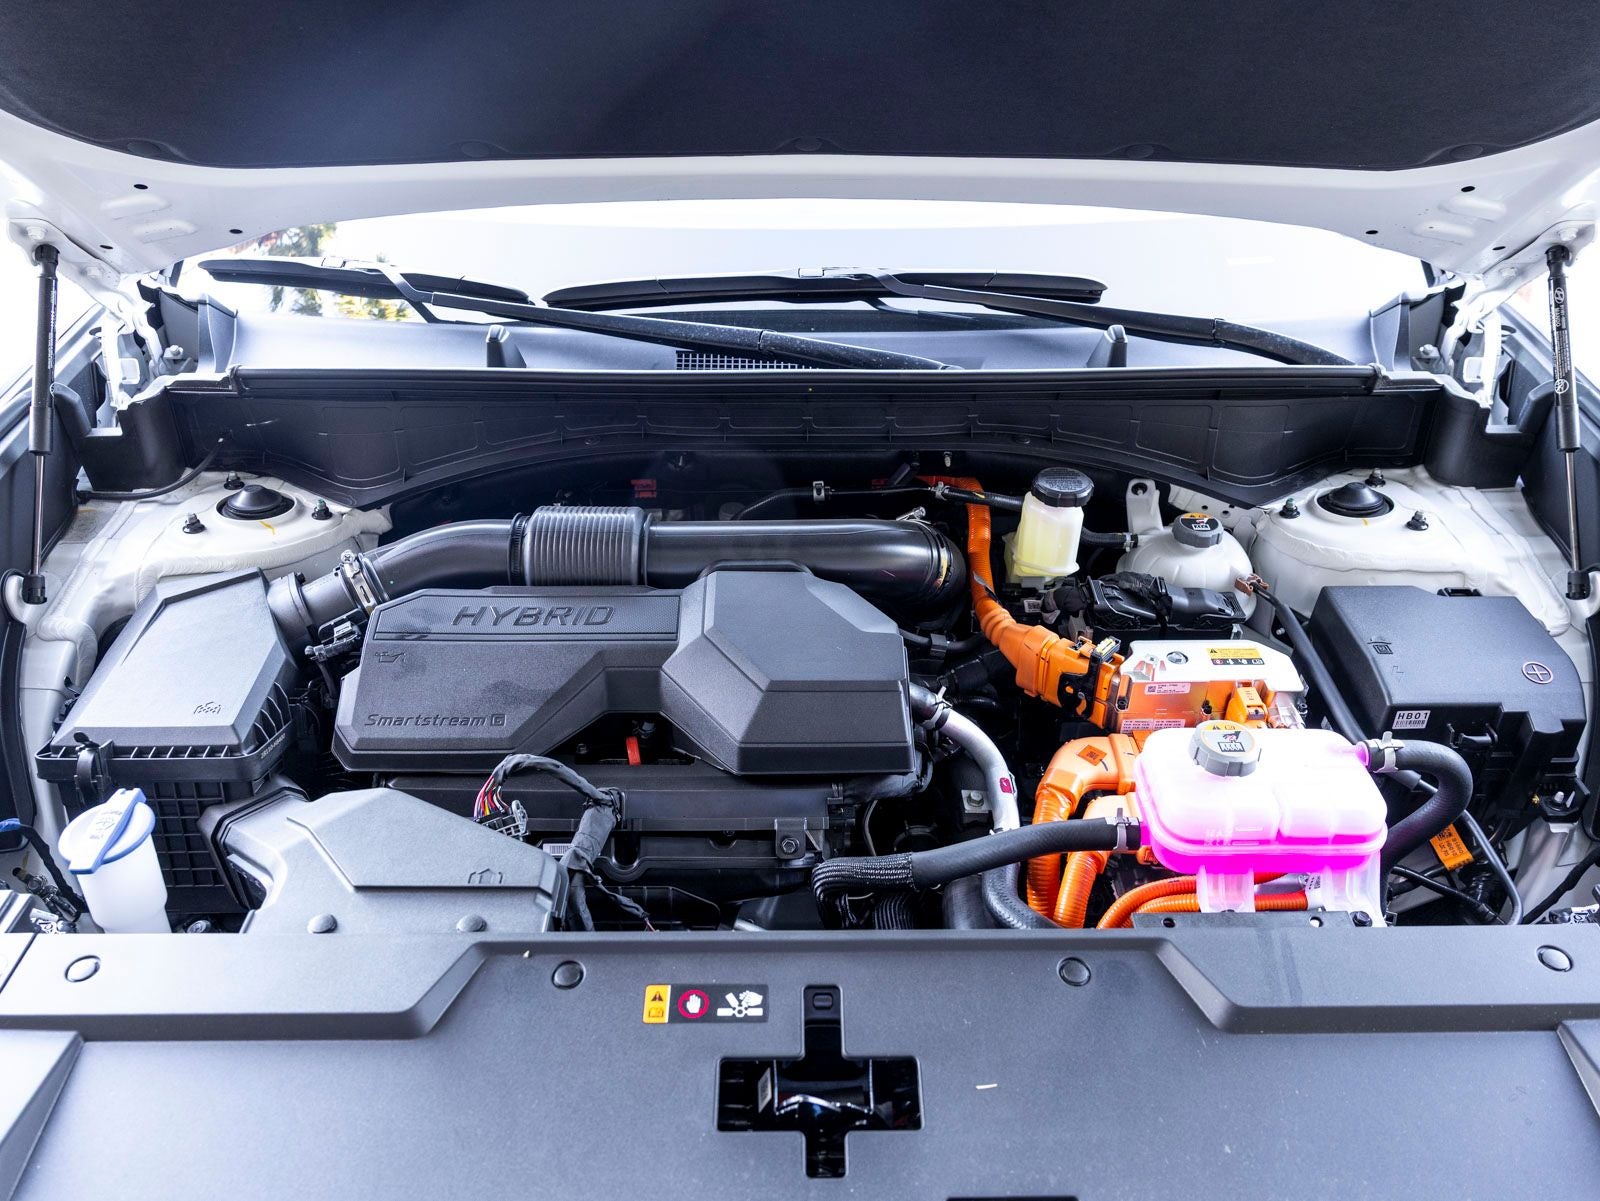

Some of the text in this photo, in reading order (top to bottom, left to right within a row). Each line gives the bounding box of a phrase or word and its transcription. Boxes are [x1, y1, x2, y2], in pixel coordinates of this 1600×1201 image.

[451, 605, 615, 626] HYBRID
[364, 713, 487, 727] Smartstream
[1397, 711, 1429, 720] HB01
